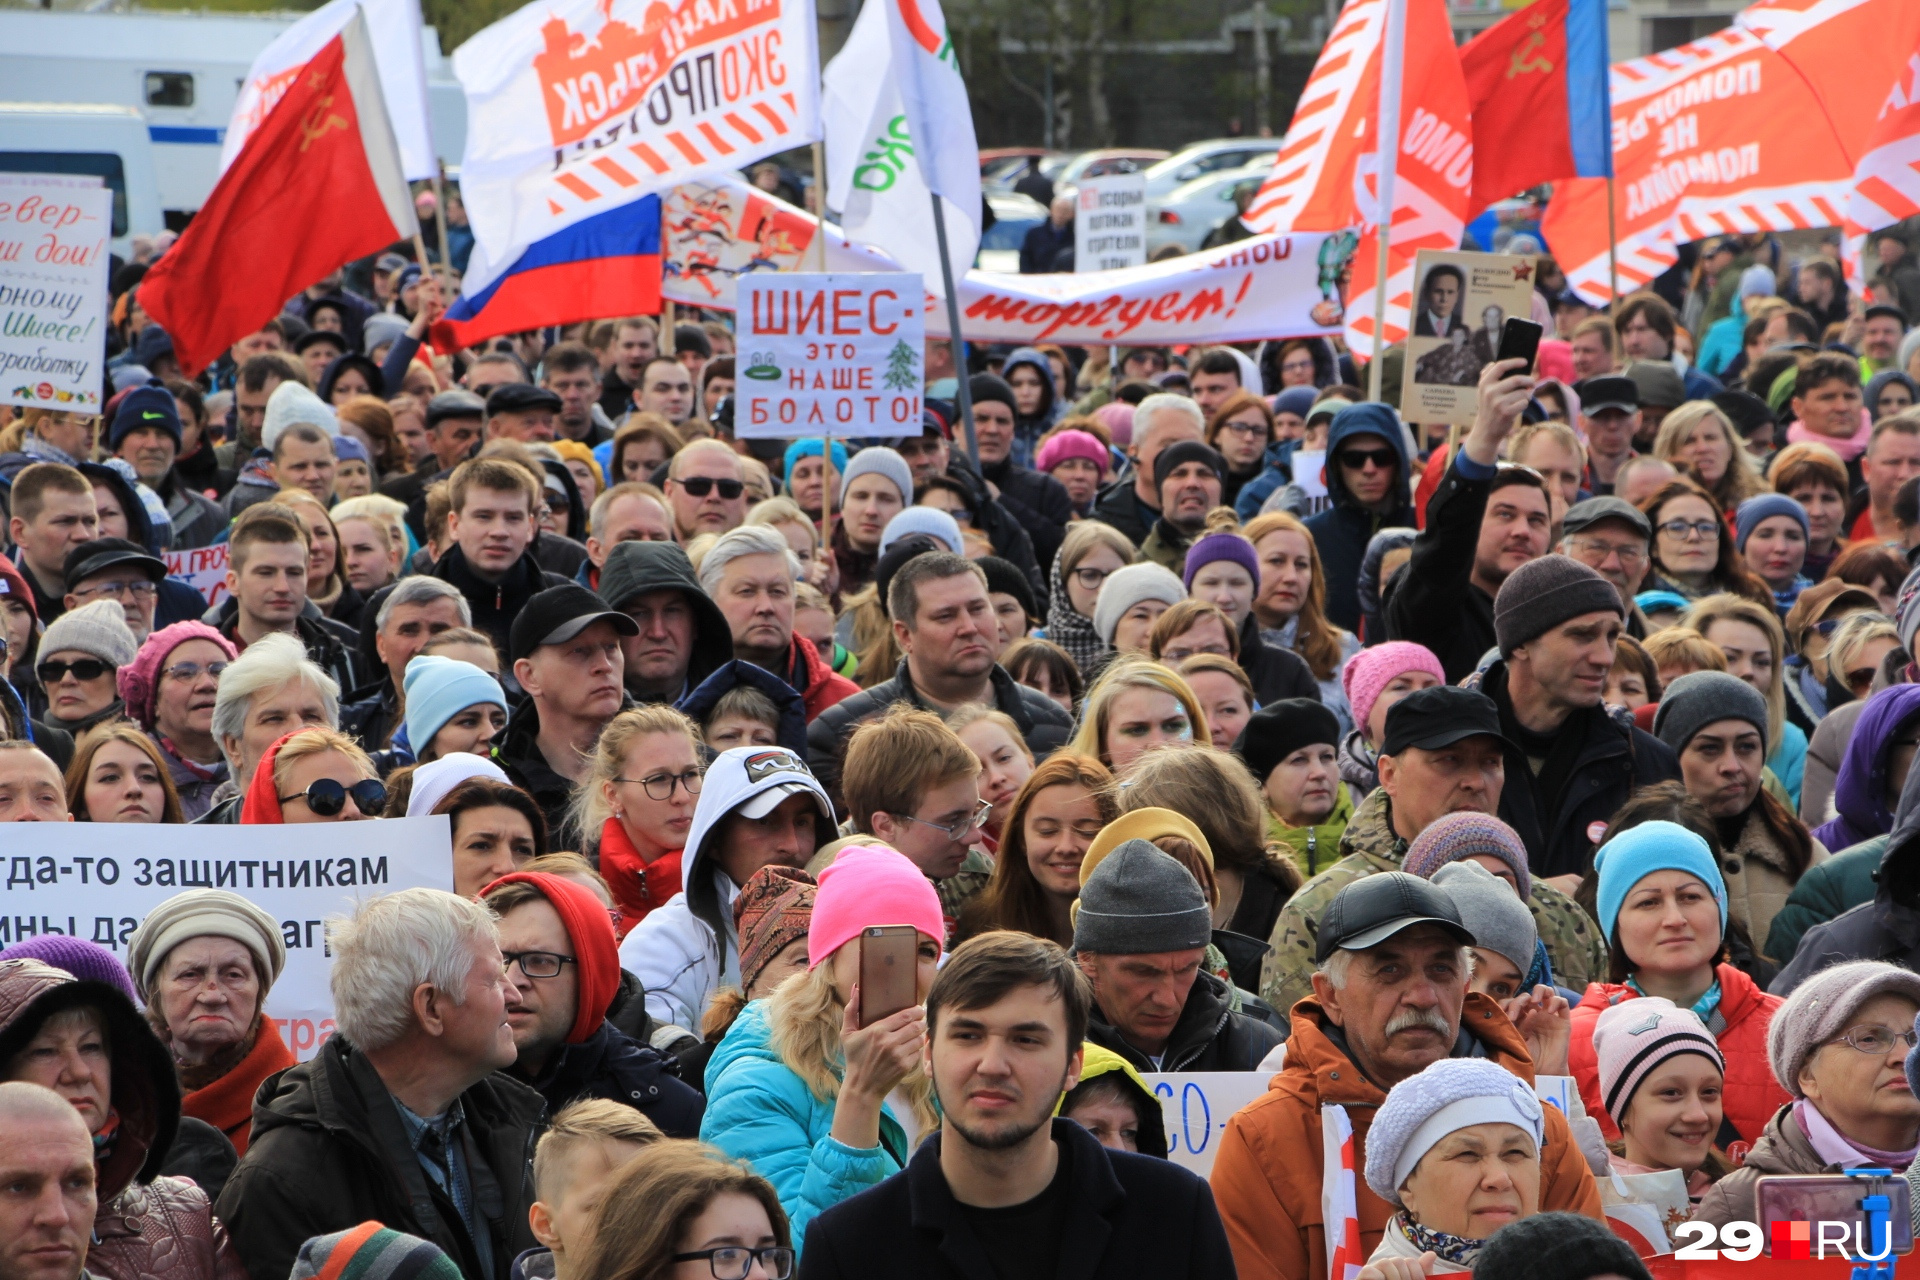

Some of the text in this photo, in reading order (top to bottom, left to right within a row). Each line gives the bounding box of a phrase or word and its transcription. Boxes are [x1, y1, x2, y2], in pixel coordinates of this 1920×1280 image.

[966, 272, 1253, 340] торгуем!
[806, 343, 856, 360] ЭТО
[789, 367, 873, 391] НАШЕ
[752, 396, 919, 424] БОЛОТО!
[0, 855, 389, 890] да-то защитникам
